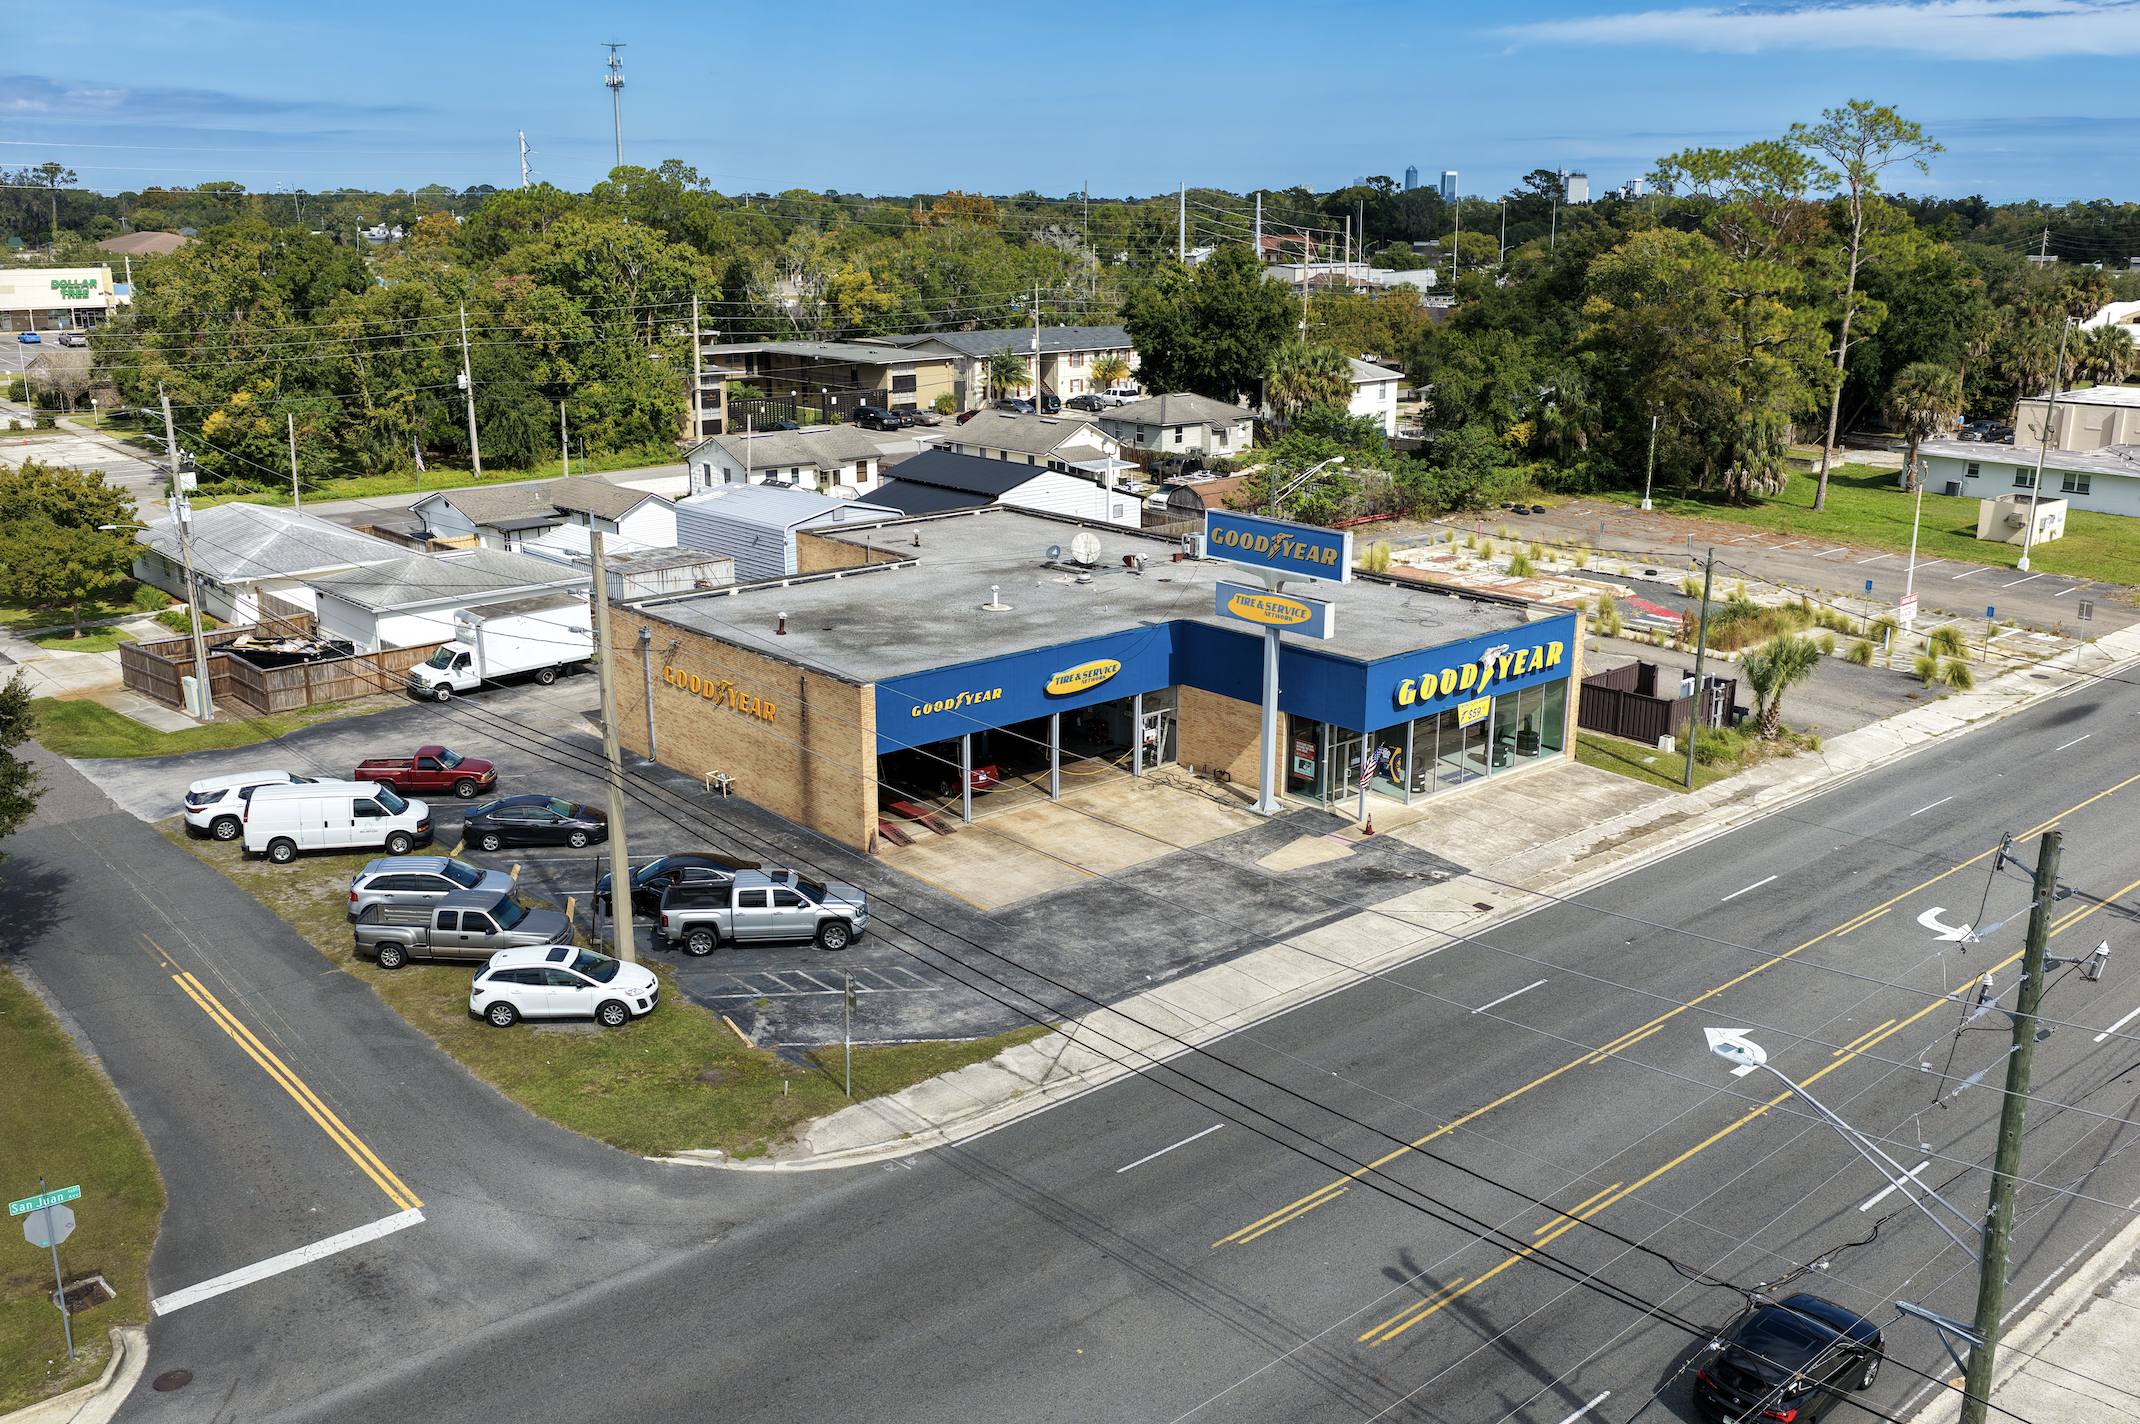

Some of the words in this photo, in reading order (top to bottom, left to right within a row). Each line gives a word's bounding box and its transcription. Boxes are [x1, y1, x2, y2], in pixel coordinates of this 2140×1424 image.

[51, 279, 97, 290] DOLLAR
[60, 289, 89, 299] TREE
[1235, 595, 1255, 608] TIRE
[1256, 600, 1264, 610] &
[1264, 602, 1307, 619] SERVICE
[1263, 610, 1293, 622] NETWORK
[1055, 674, 1075, 686] TIRE
[1074, 673, 1081, 682] &
[1082, 664, 1118, 680] SERVICE
[1081, 674, 1107, 685] NETWORK
[11, 1202, 33, 1213] San
[36, 1194, 64, 1208] Juan
